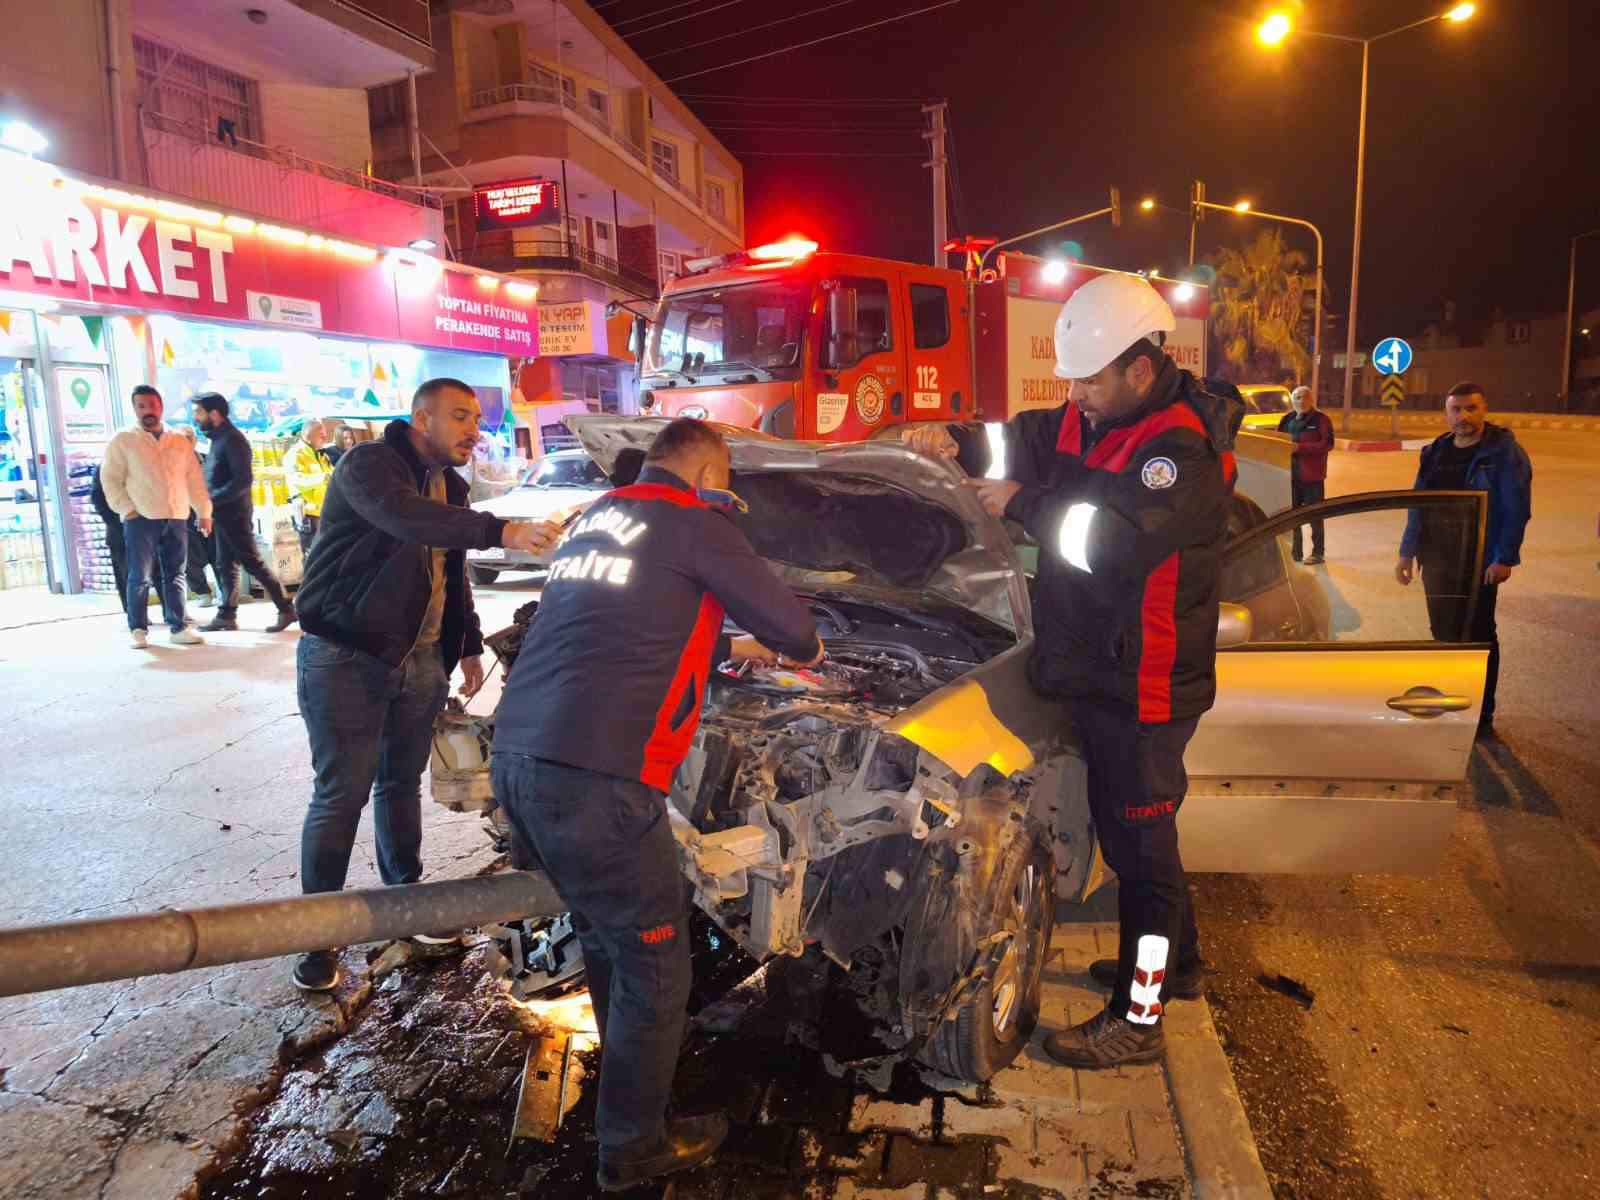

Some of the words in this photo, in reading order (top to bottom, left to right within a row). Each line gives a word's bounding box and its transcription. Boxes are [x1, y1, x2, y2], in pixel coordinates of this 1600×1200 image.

[437, 296, 481, 315] TOPTAN
[484, 303, 529, 324] FİYATINA
[435, 316, 500, 339] PERAKENDE
[505, 328, 532, 347] SATIŞ
[916, 365, 938, 389] 112
